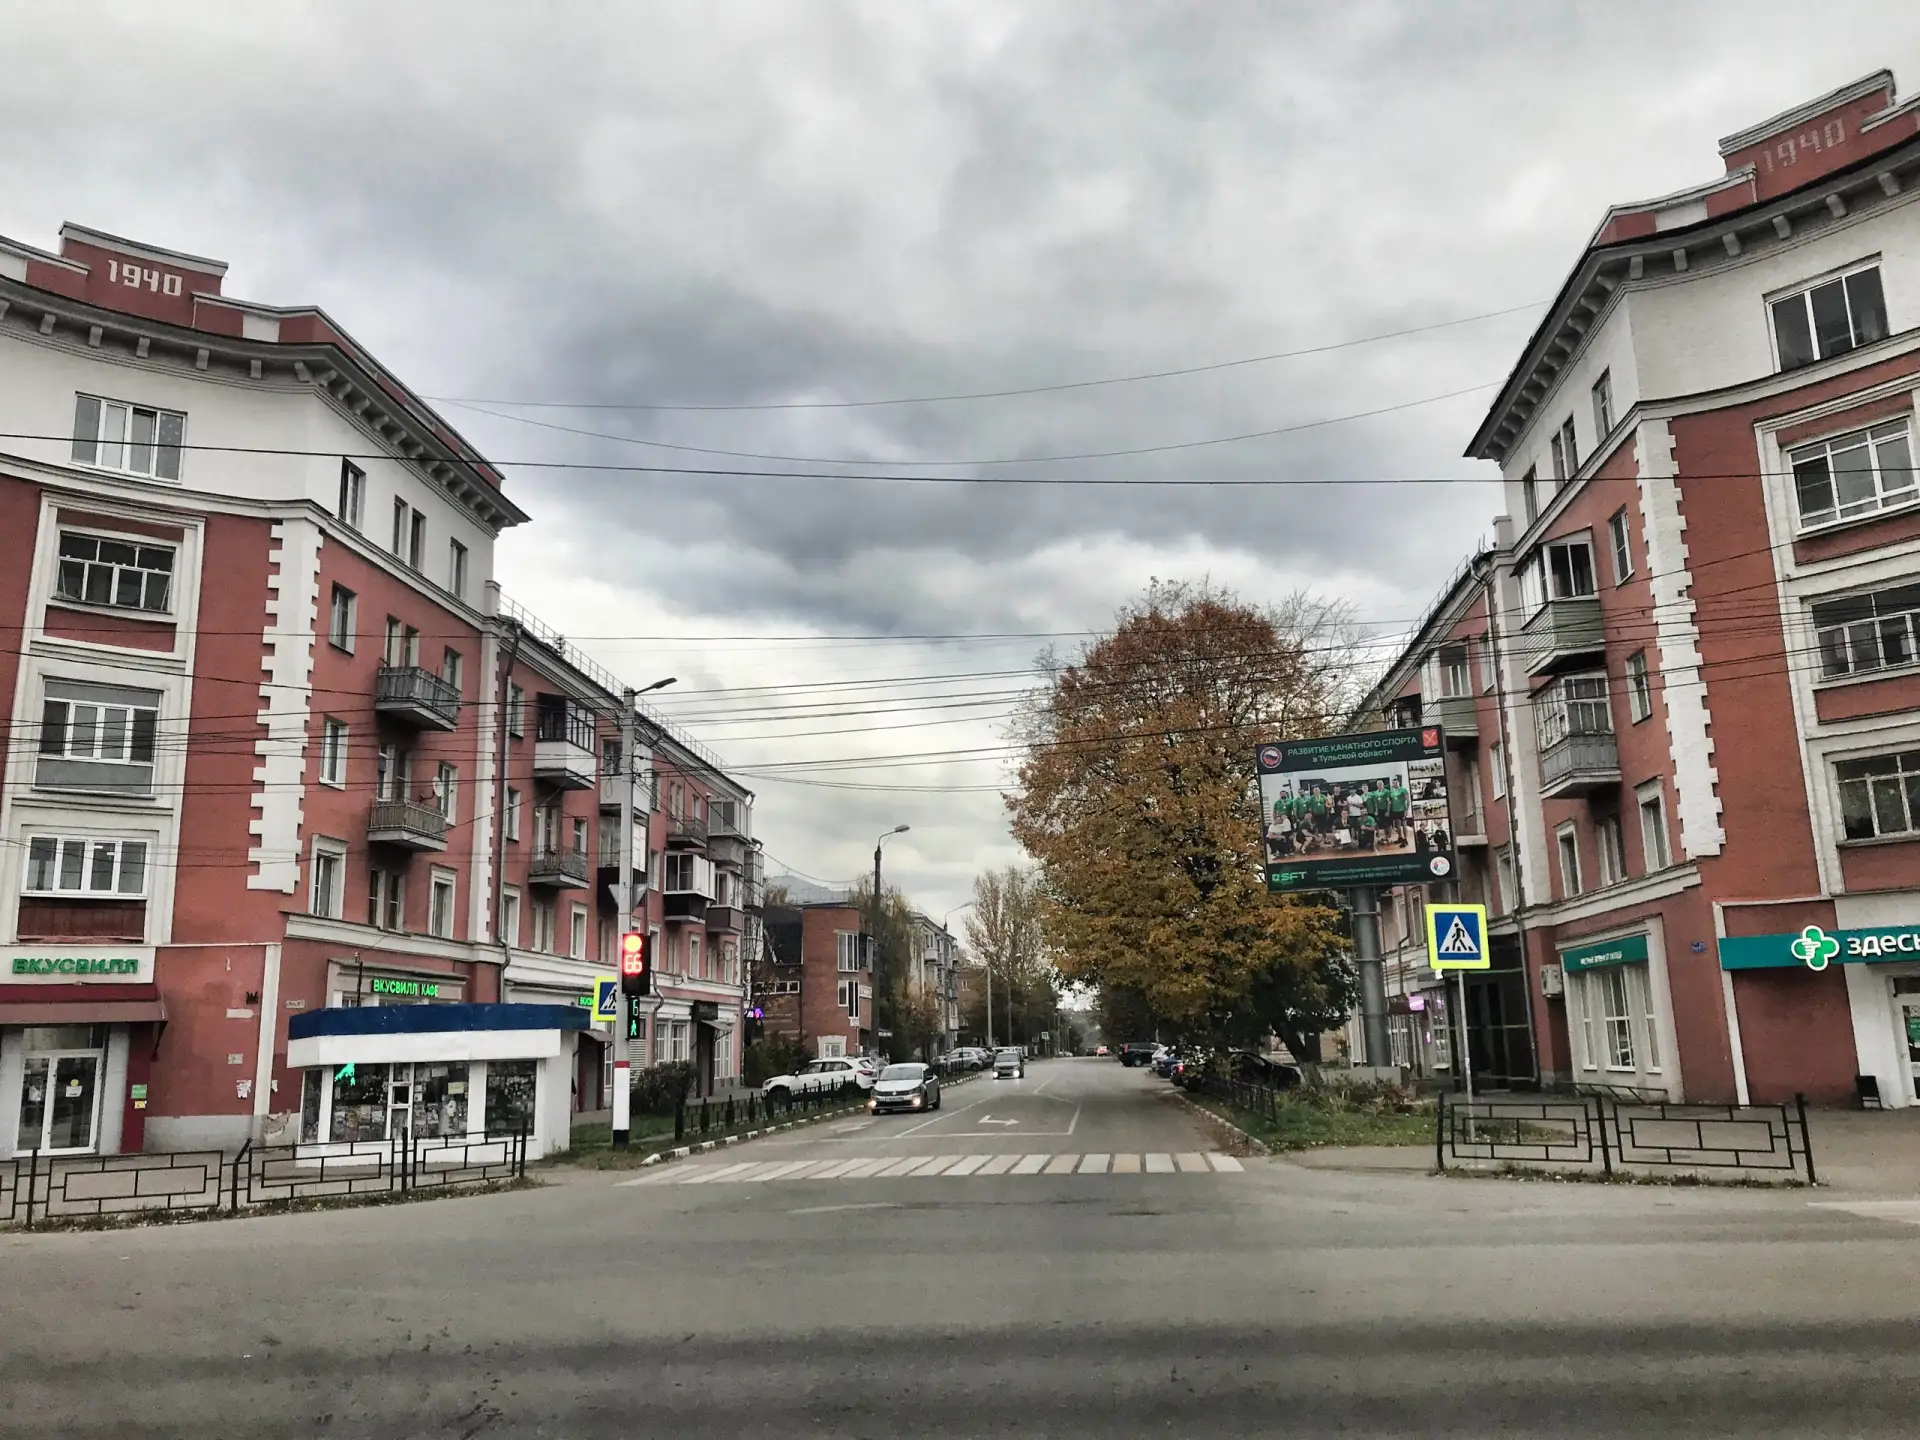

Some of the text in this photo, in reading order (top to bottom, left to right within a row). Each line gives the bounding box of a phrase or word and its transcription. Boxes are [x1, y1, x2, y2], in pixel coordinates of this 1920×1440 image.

[1762, 118, 1846, 173] 1940
[108, 259, 183, 297] 1940
[1287, 736, 1417, 756] РАЗВИТИЕ КАНАТНОГО СПОРТА
[1319, 752, 1357, 763] Тульской
[1358, 749, 1393, 758] области
[12, 958, 139, 974] ВКУСВИЛЛ
[624, 953, 643, 973] 66
[373, 978, 439, 997] ВКУСВИЛЛ КАФЕ
